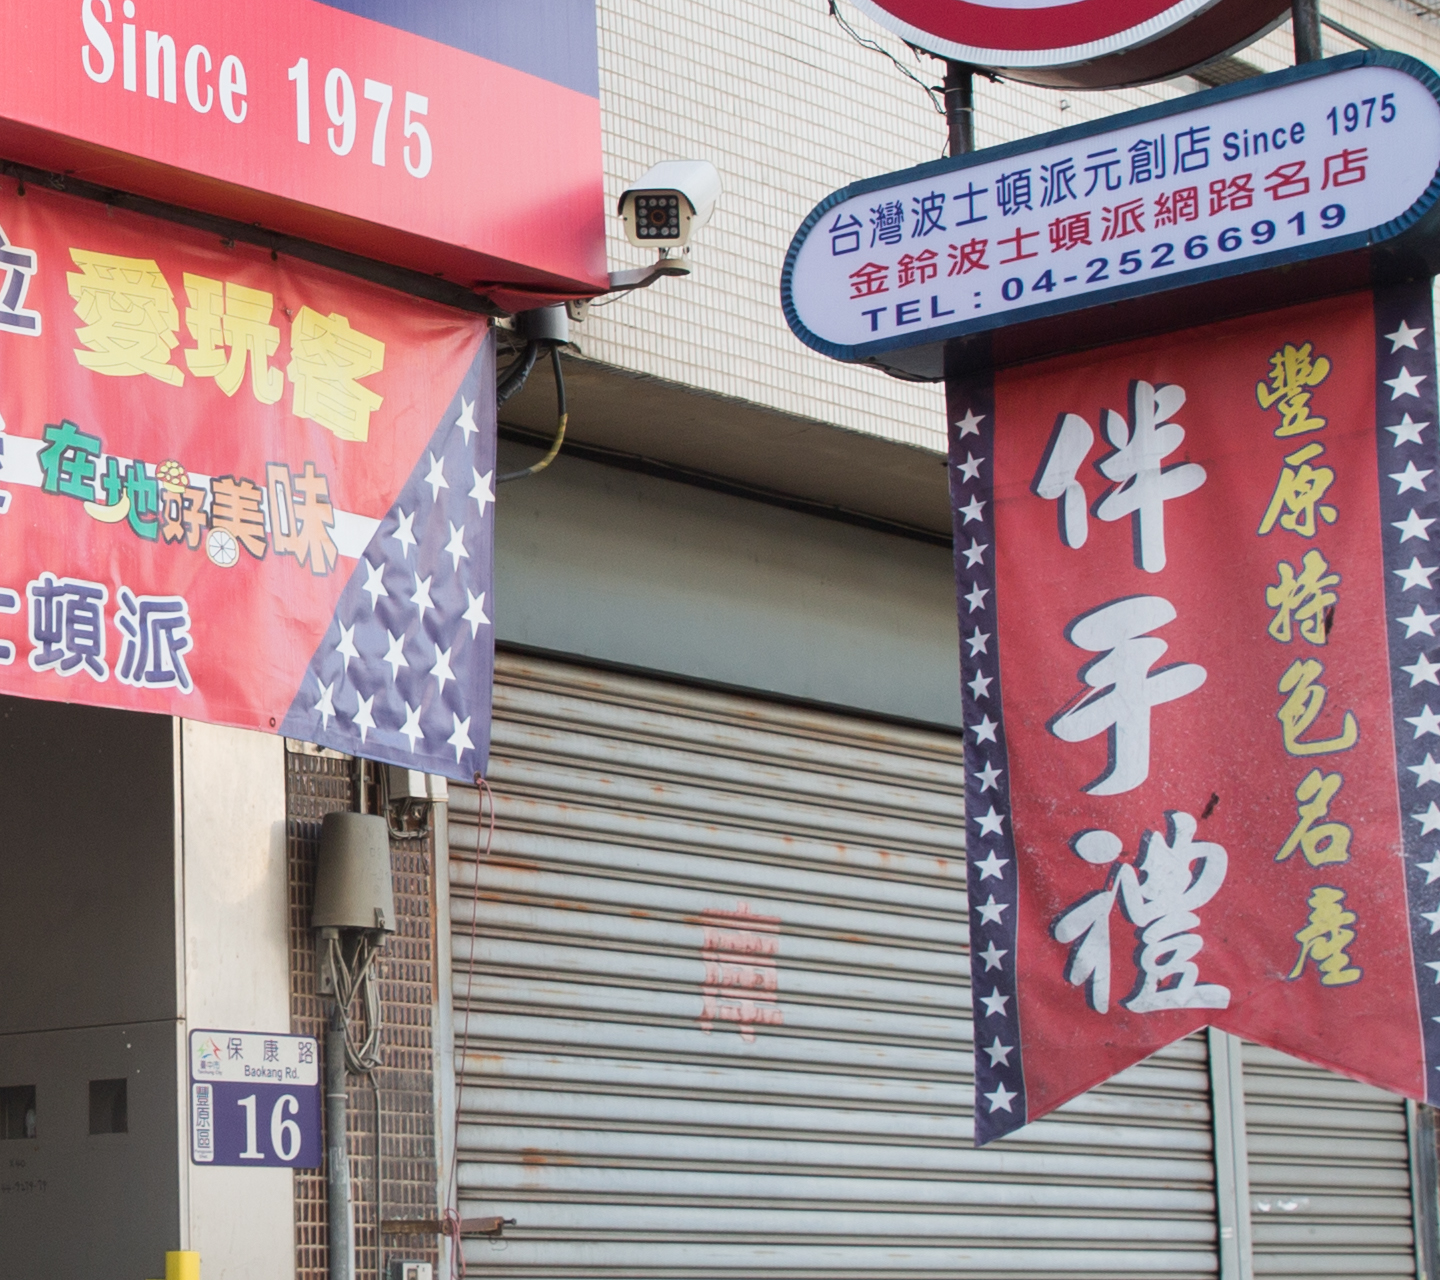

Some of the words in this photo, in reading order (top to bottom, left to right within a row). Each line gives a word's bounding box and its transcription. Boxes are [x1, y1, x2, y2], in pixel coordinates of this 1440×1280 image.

[287, 56, 434, 180] 1975
[826, 122, 1211, 258] 台灣波士頓派元創店
[1222, 121, 1306, 163] Since
[1325, 91, 1398, 137] 1975
[846, 145, 1370, 302] 金鈴波士頓派網路名店
[1000, 202, 1348, 303] 04-25266919
[68, 247, 386, 443] 愛玩客
[35, 420, 340, 577] 在地好美味
[1031, 379, 1231, 1014] 伴手禮
[1256, 340, 1361, 987] 豐原特色名產
[226, 1036, 314, 1065] 保康路
[237, 1093, 302, 1161] 16
[244, 1064, 283, 1082] Baokang
[285, 1066, 300, 1080] Rd.
